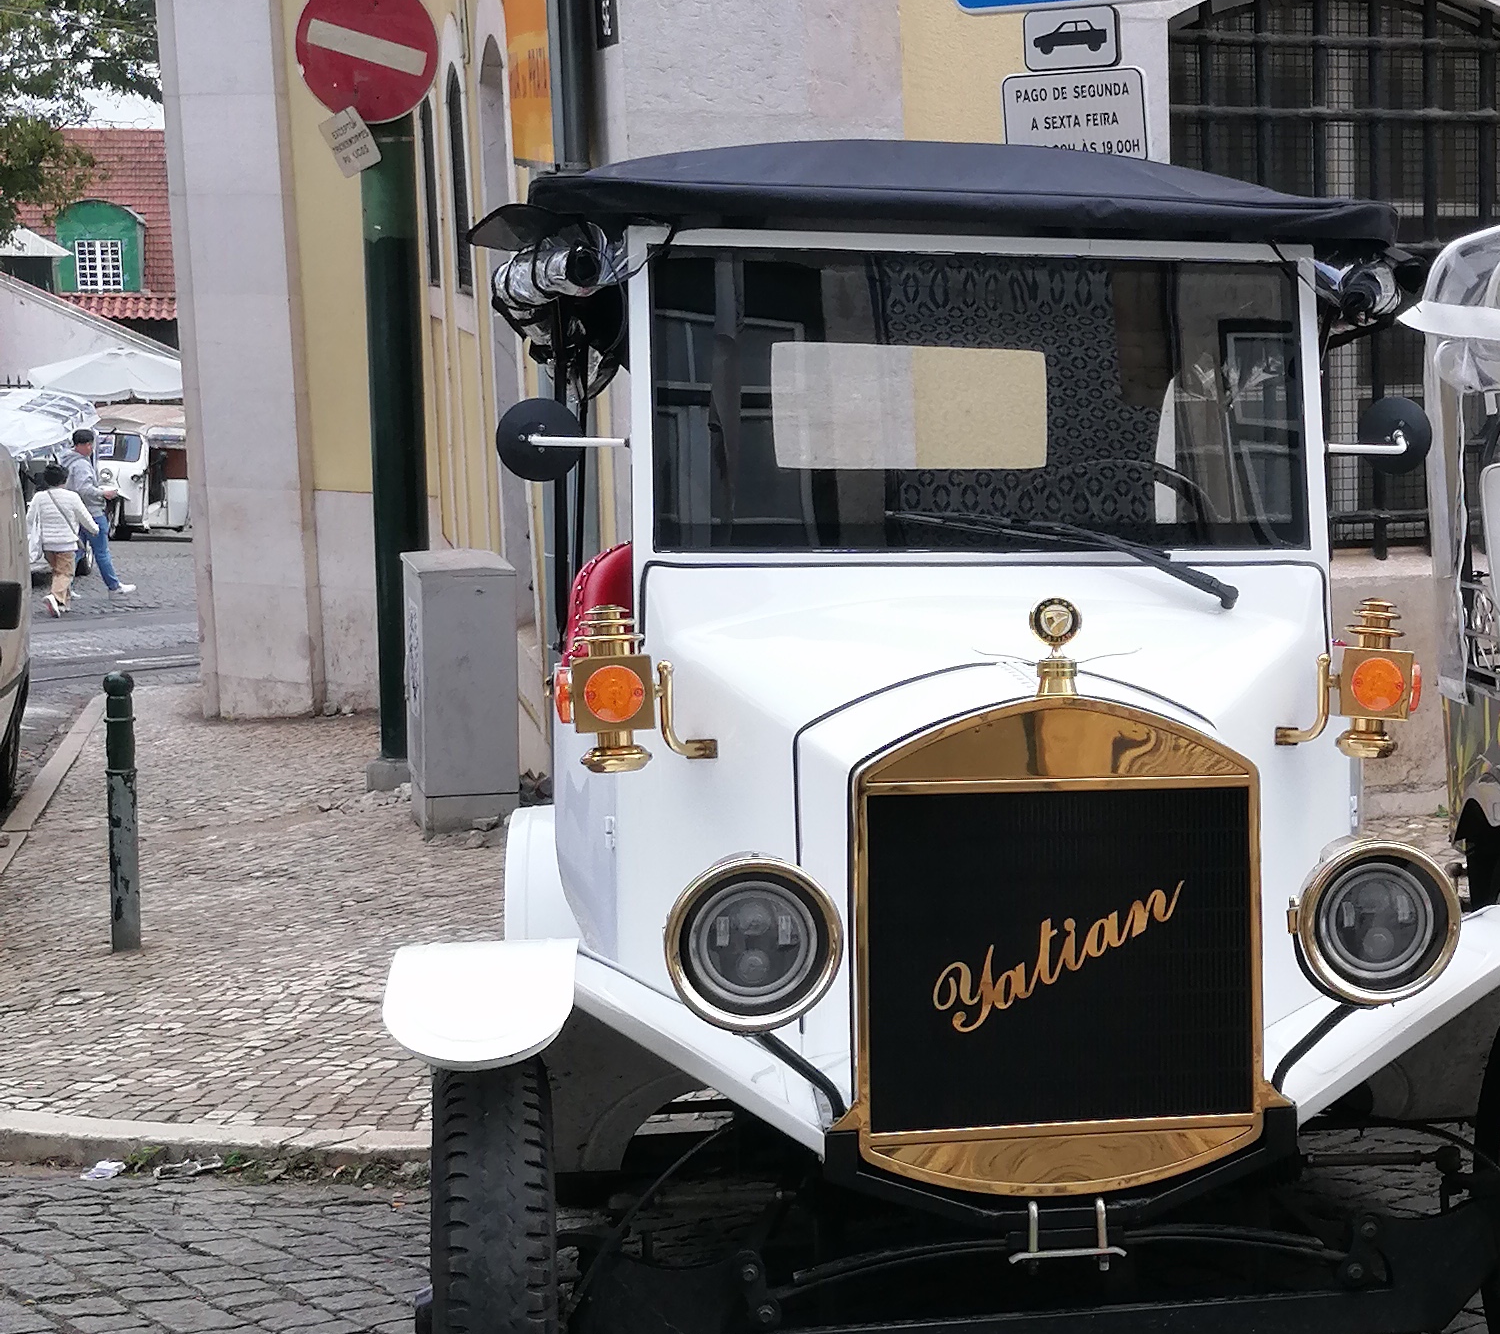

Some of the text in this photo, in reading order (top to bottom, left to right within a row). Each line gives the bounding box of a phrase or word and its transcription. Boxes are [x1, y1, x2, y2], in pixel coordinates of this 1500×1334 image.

[1015, 82, 1130, 103] PAGO DE SEGUNDA
[1031, 111, 1119, 131] A SEXTA FEIRA
[1101, 139, 1141, 155] 19.00H
[933, 879, 1185, 1033] Yatian
